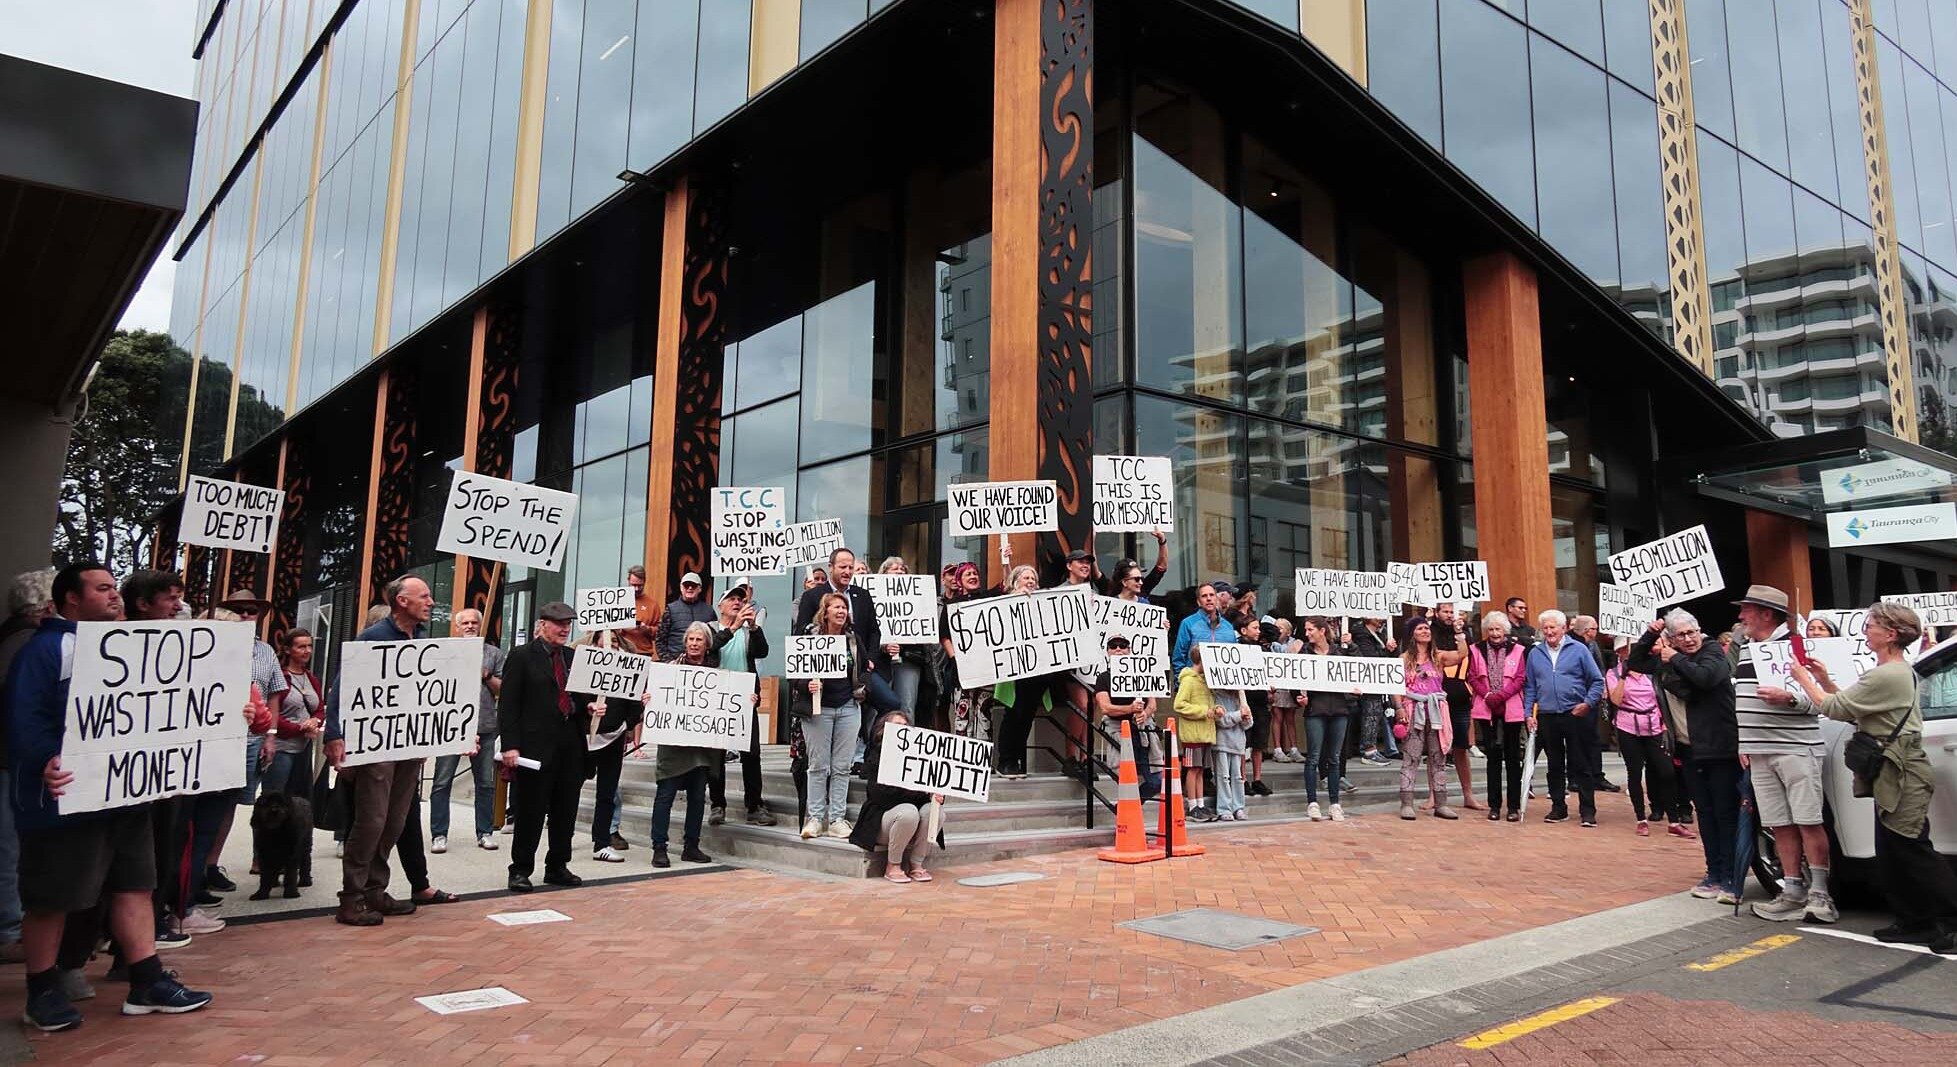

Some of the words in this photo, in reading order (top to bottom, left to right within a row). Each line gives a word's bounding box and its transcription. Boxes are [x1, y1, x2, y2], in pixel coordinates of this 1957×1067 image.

[1107, 457, 1147, 481] TCC
[194, 480, 232, 506] TOO
[235, 487, 278, 512] MUCH
[454, 479, 510, 514] STOP
[520, 498, 562, 525] THE
[952, 489, 979, 507] WE
[985, 488, 1014, 506] HAVE
[1017, 486, 1055, 505] FOUND
[1095, 483, 1133, 498] THIS
[1140, 483, 1162, 500] IS
[722, 511, 766, 528] STOP
[959, 509, 992, 531] OUR
[996, 505, 1048, 527] VOICE!
[1093, 501, 1116, 526] OUR
[1118, 500, 1173, 526] MESSAGE!
[1871, 517, 1922, 528] Tauranga
[1923, 515, 1940, 525] City
[204, 510, 273, 552] DEBT!
[457, 516, 563, 566] SPEND!
[714, 532, 786, 548] WASTING
[801, 520, 842, 541] MILLION
[741, 547, 762, 555] OUR
[785, 545, 817, 565] FIND
[721, 555, 780, 573] MONEY
[1422, 563, 1476, 582] LISTEN
[885, 576, 923, 597] HAVE
[1300, 571, 1317, 587] WE
[1324, 572, 1350, 588] HAVE
[1354, 573, 1386, 589] FOUND
[1428, 583, 1453, 599] TO
[1461, 576, 1486, 599] US!
[1676, 560, 1711, 595] IT!
[587, 589, 626, 607] STOP
[1305, 590, 1337, 609] OUR
[1342, 592, 1387, 611] VOICE!
[1602, 586, 1629, 605] BUILD
[1632, 593, 1655, 611] TRUST
[579, 607, 636, 626] SPENDING
[873, 601, 914, 619] OUND
[1621, 606, 1634, 616] AND
[888, 618, 937, 638] VOICE!
[950, 606, 1005, 655] $40
[1009, 593, 1090, 642] MILLION
[795, 636, 836, 651] STOP
[1131, 634, 1158, 657] CPI
[100, 627, 215, 688] STOP
[371, 643, 440, 679] TCC
[585, 649, 614, 666] TOO
[616, 655, 646, 671] MUCH
[787, 653, 846, 673] SPENDING
[993, 644, 1037, 679] FIND
[1047, 637, 1079, 667] IT!
[1119, 656, 1158, 673] STOP
[1206, 645, 1241, 665] TOO
[680, 669, 718, 690] TCC
[1112, 669, 1171, 696] SPENDING!
[1327, 661, 1405, 685] RATEPAYERS
[351, 684, 400, 711] ARE
[416, 678, 457, 707] YOU
[590, 670, 640, 698] DEBT!
[660, 687, 709, 709] THIS
[717, 692, 742, 714] IS
[75, 682, 225, 742] WASTING
[645, 710, 672, 729] OUR
[342, 703, 475, 755] LISTENING?
[105, 739, 202, 802] MONEY!
